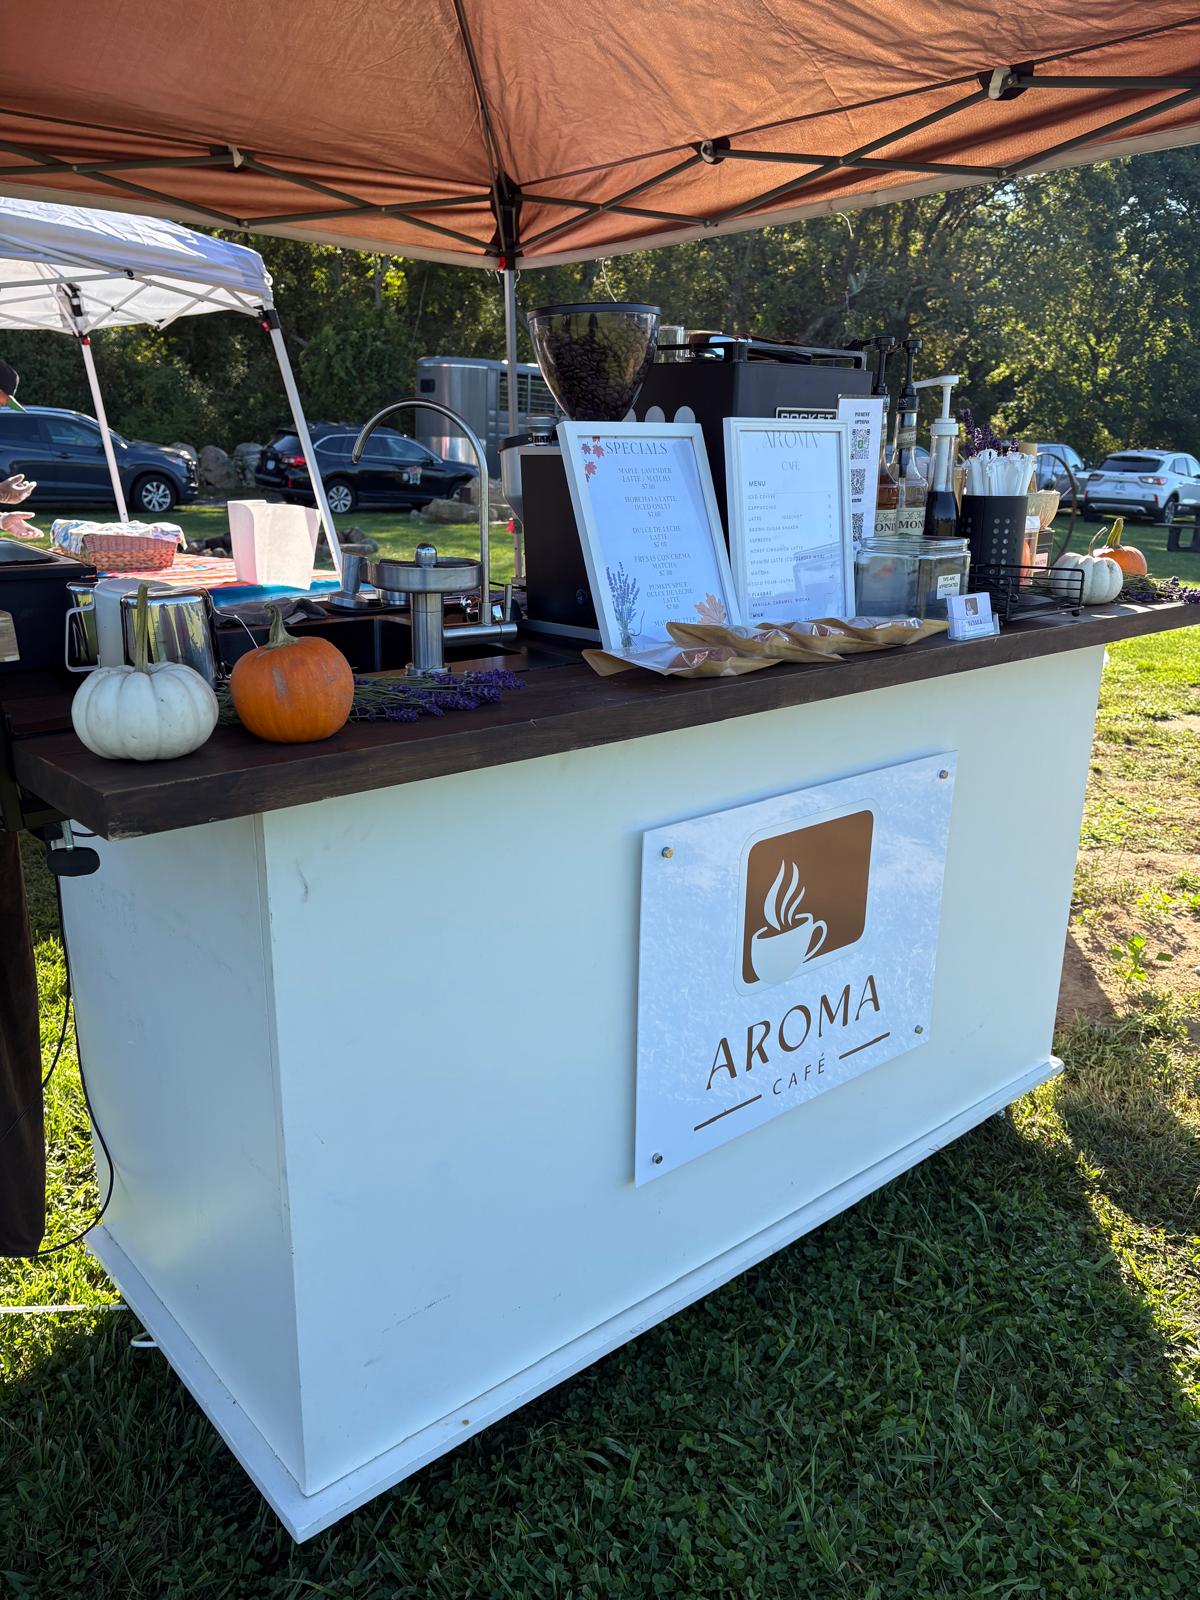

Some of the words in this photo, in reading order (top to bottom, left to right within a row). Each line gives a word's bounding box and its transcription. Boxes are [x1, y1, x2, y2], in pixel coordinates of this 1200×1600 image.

[605, 441, 668, 455] SPECIALS
[762, 431, 818, 449] AROMA
[641, 466, 673, 474] LAVENDER
[748, 480, 767, 488] MENU
[706, 974, 881, 1092] AROMA
[772, 1052, 826, 1096] CAFÉ
